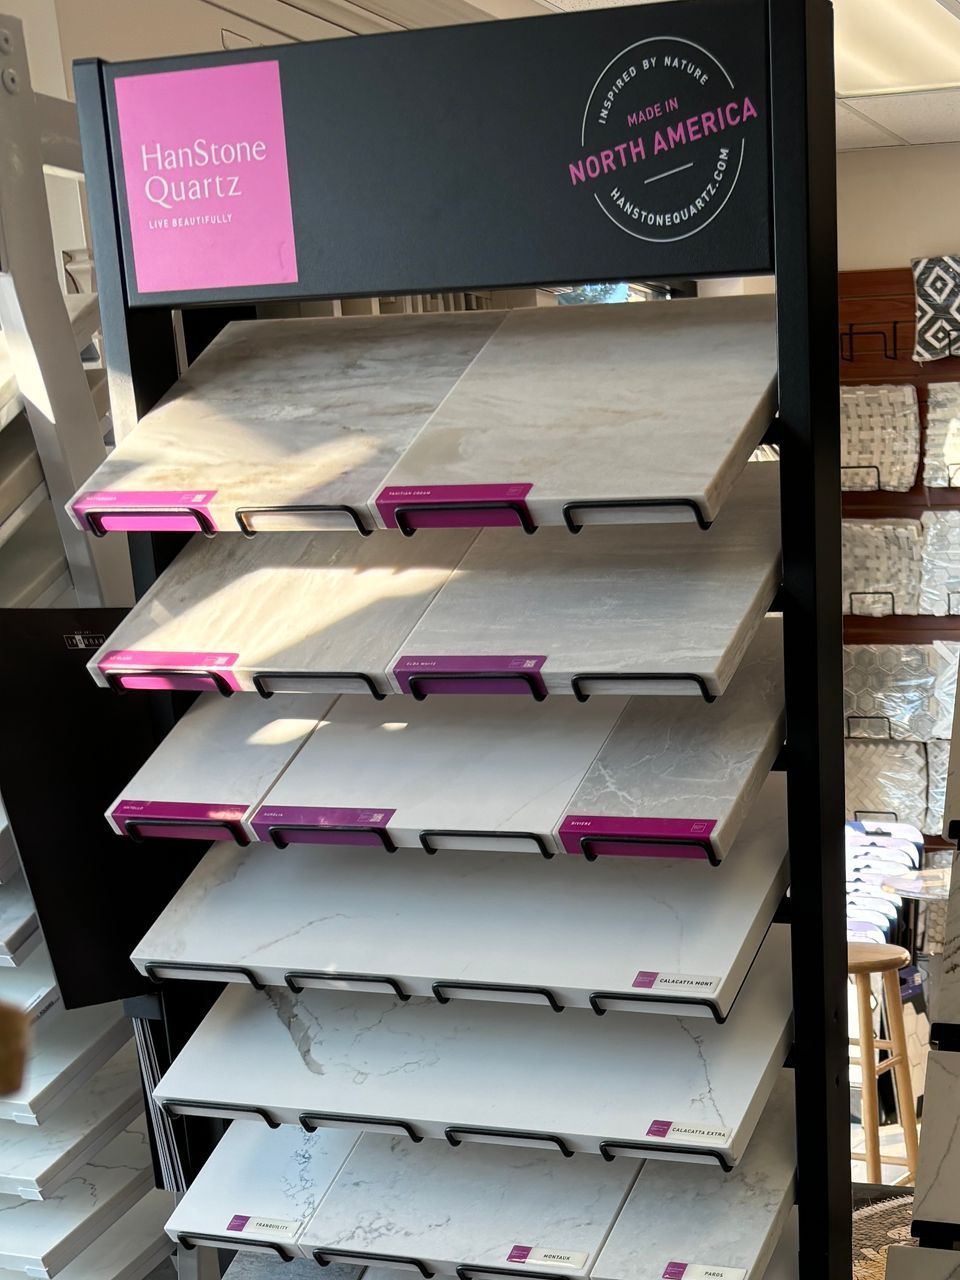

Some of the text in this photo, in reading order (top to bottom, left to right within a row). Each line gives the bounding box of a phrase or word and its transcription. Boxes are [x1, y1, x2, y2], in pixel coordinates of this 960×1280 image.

[597, 56, 709, 124] INSPIRED BY NATURE
[627, 97, 680, 127] MADE IN
[141, 138, 267, 171] HanStone
[568, 96, 758, 186] NORTH AMERICA
[144, 175, 242, 209] Quartz
[610, 147, 730, 226] HANSTONEQUARTZ.COM
[149, 213, 233, 230] LIVE BEAUTIFULLY
[660, 977, 691, 986] CALACATTA
[671, 1127, 705, 1136] CALACATTA
[706, 1129, 726, 1138] EXTRA
[255, 1222, 289, 1230] TRANQUILITY
[543, 1253, 571, 1261] MONTAUK
